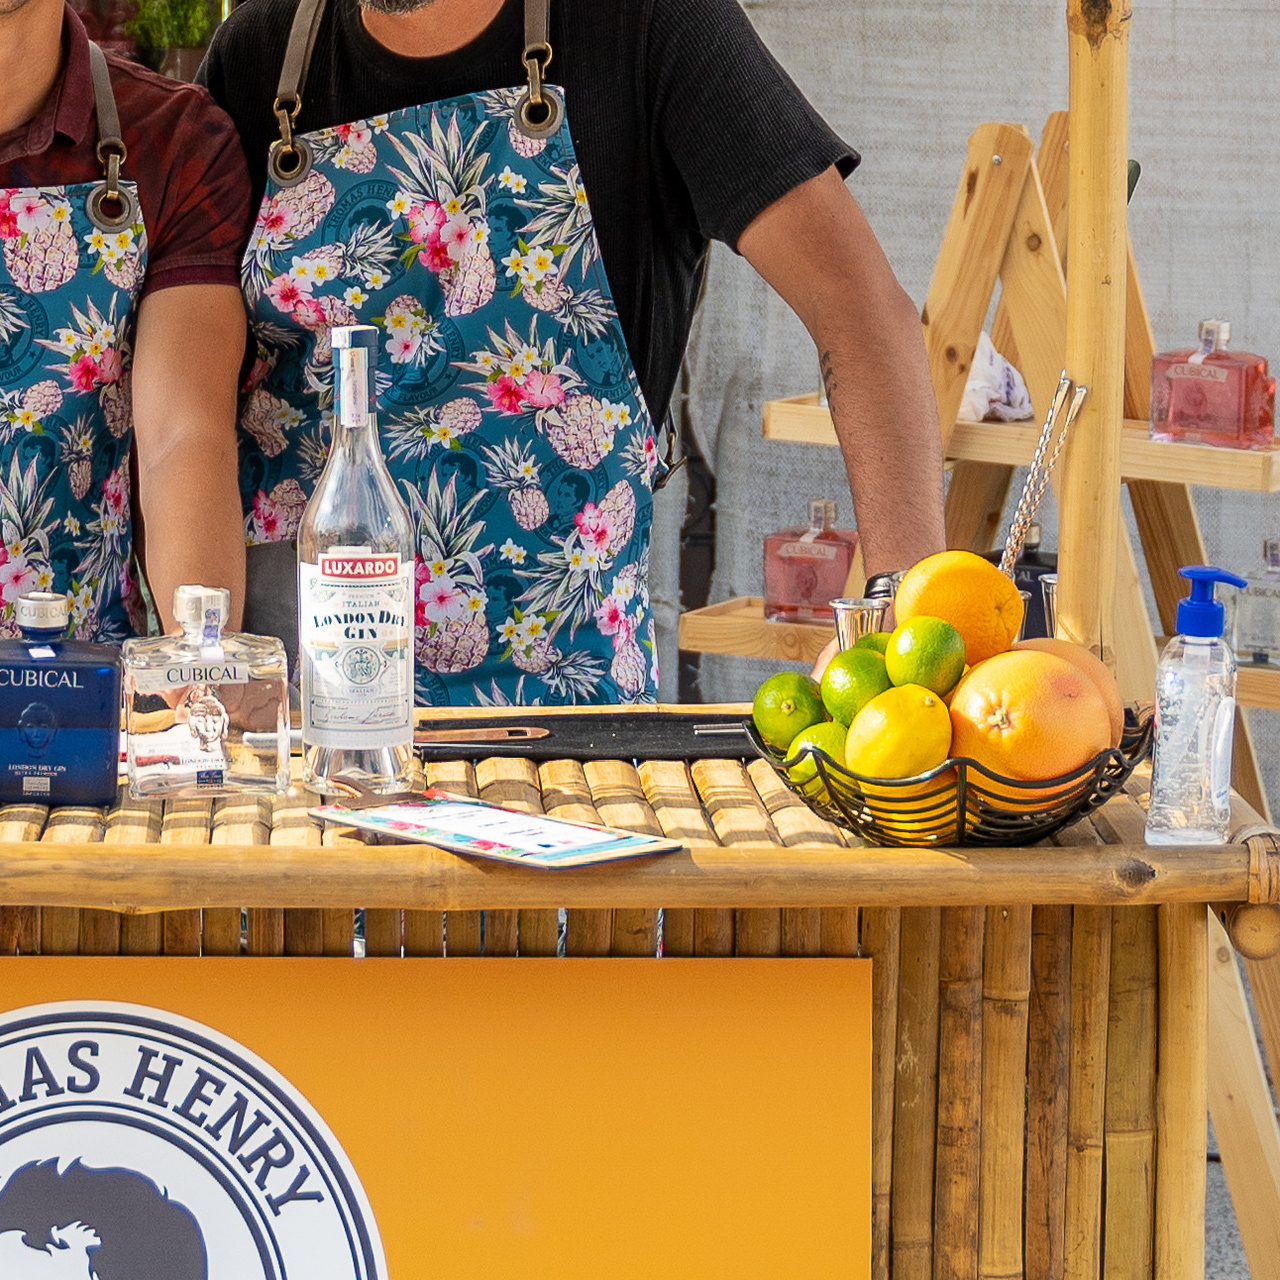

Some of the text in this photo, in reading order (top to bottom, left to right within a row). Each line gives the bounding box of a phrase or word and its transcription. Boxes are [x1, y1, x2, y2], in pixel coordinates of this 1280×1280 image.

[326, 187, 364, 230] THOMAS
[24, 299, 45, 337] HENRY
[442, 322, 461, 360] HENRY
[1174, 366, 1219, 379] CUBICAL
[398, 386, 440, 402] FLAVOUR
[324, 560, 395, 575] LUXARDO
[1239, 586, 1280, 598] CUBICA
[341, 600, 380, 608] ITALIAN
[20, 606, 69, 619] CUBICAL
[313, 610, 405, 628] LONDON DRY
[343, 626, 378, 640] GIN
[166, 665, 244, 683] CUBICAL
[121, 1045, 324, 1217] HENRY
